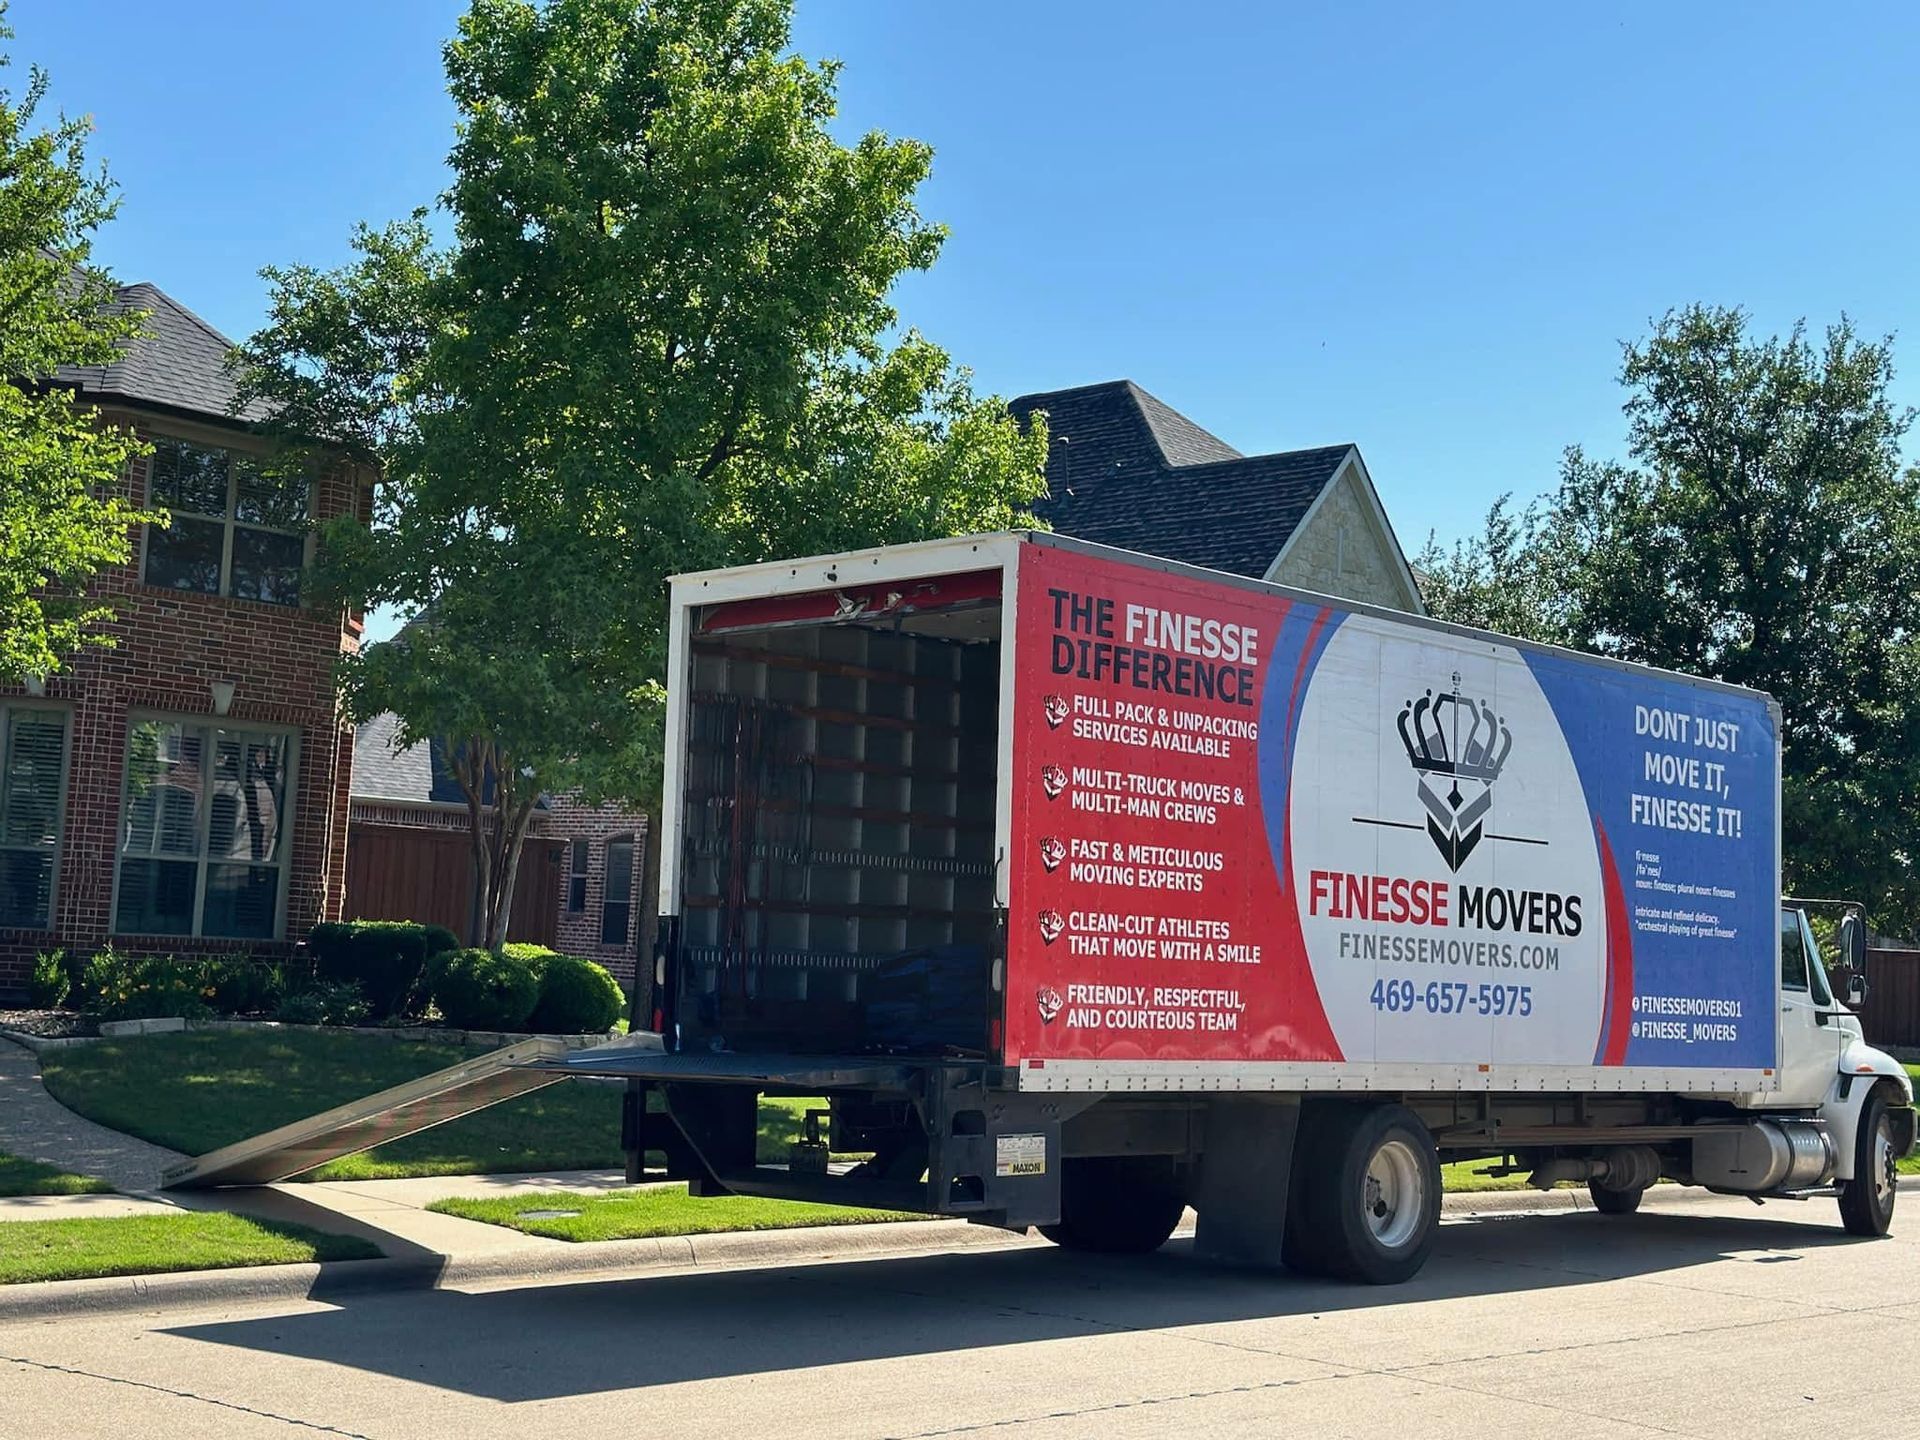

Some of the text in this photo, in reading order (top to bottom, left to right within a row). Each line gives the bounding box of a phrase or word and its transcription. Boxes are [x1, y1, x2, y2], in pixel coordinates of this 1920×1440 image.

[1048, 588, 1258, 665] THE FINESSE
[1052, 634, 1254, 706] DIFFERENCE
[1074, 695, 1258, 740] FULL PACK & UNPACKING
[1635, 705, 1739, 752] DONT JUST
[1073, 718, 1230, 758] SERVICES AVAILABLE
[1072, 767, 1245, 806] MULTI-TRUCK MOVES &
[1645, 751, 1729, 800] MOVE IT,
[1072, 791, 1216, 824] MULTI-MAN CREWS
[1631, 793, 1741, 838] FINESSE IT!
[1070, 838, 1223, 871] FAST & METICULOUS
[1070, 862, 1203, 892] MOVING EXPERTS
[1677, 883, 1695, 894] plural
[1309, 870, 1583, 937] FINESSE MOVERS
[1635, 905, 1660, 918] intricate
[1661, 909, 1672, 919] and
[1673, 910, 1694, 921] refined
[1068, 911, 1229, 940] CLEAN-CUT ATHLETES
[1668, 923, 1690, 937] playing
[1691, 925, 1698, 935] of
[1698, 926, 1713, 938] great
[1068, 935, 1261, 964] THAT MOVE WITH A SMILE
[1339, 932, 1559, 971] FINESSEMOVERS.COM
[1067, 984, 1246, 1012] FRIENDLY, RESPECTFUL,
[1370, 978, 1532, 1016] 469-657-5975
[1641, 996, 1742, 1017] FINESSEMOVERS01
[1066, 1008, 1237, 1031] AND COURTEOUS TEAM
[1641, 1021, 1736, 1043] FINESSE_MOVERS
[1012, 1162, 1041, 1174] MAXON
